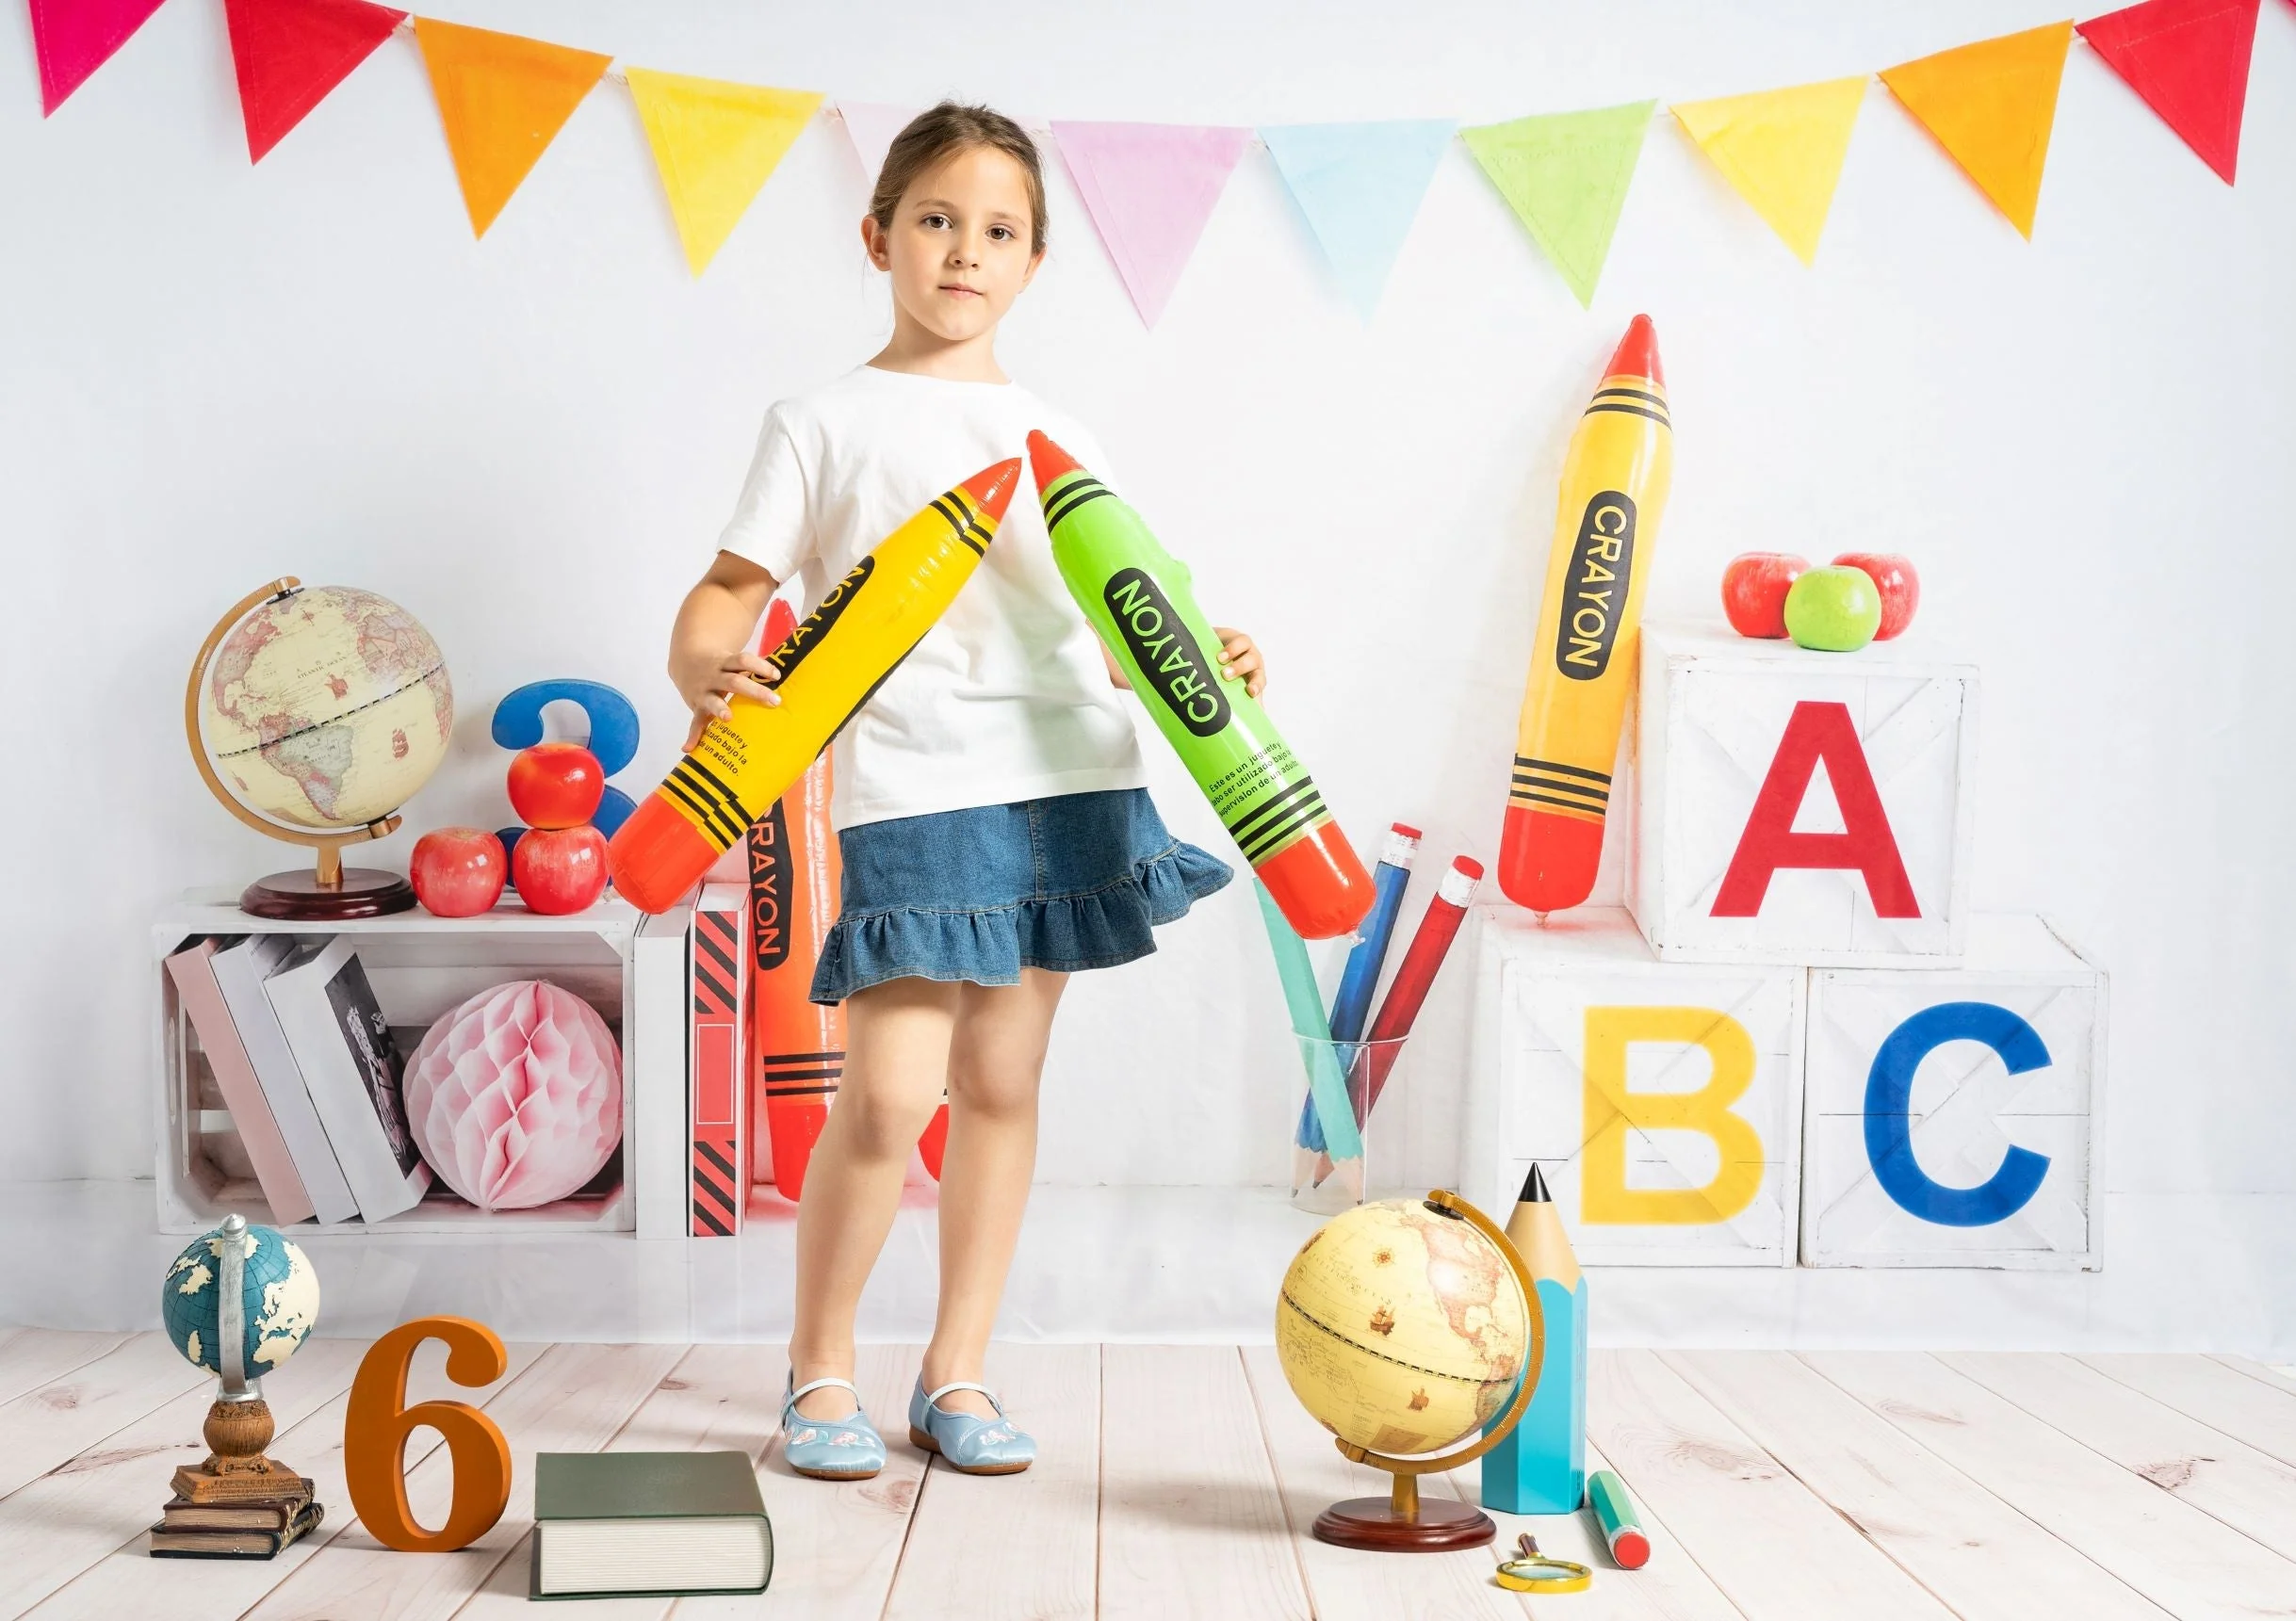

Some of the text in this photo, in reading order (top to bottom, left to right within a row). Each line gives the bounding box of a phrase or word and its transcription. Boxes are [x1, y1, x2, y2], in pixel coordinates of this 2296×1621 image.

[1113, 578, 1218, 723] CRAYON
[1565, 505, 1627, 668] CRAYON
[705, 744, 714, 754] un
[713, 751, 739, 777] adulto.
[722, 740, 740, 757] bajo
[739, 754, 747, 766] la
[1209, 779, 1226, 793] Este
[1225, 771, 1236, 782] es
[1235, 763, 1248, 773] un
[1248, 743, 1278, 766] juguete
[1223, 786, 1236, 797] ser
[1236, 760, 1274, 787] utilizado
[1258, 778, 1270, 788] de
[1270, 770, 1281, 781] un
[1708, 700, 1922, 918] A
[750, 804, 781, 955] RAYON
[1579, 1004, 1766, 1225] B
[1863, 1000, 2053, 1227] C
[345, 1314, 513, 1552] 6
